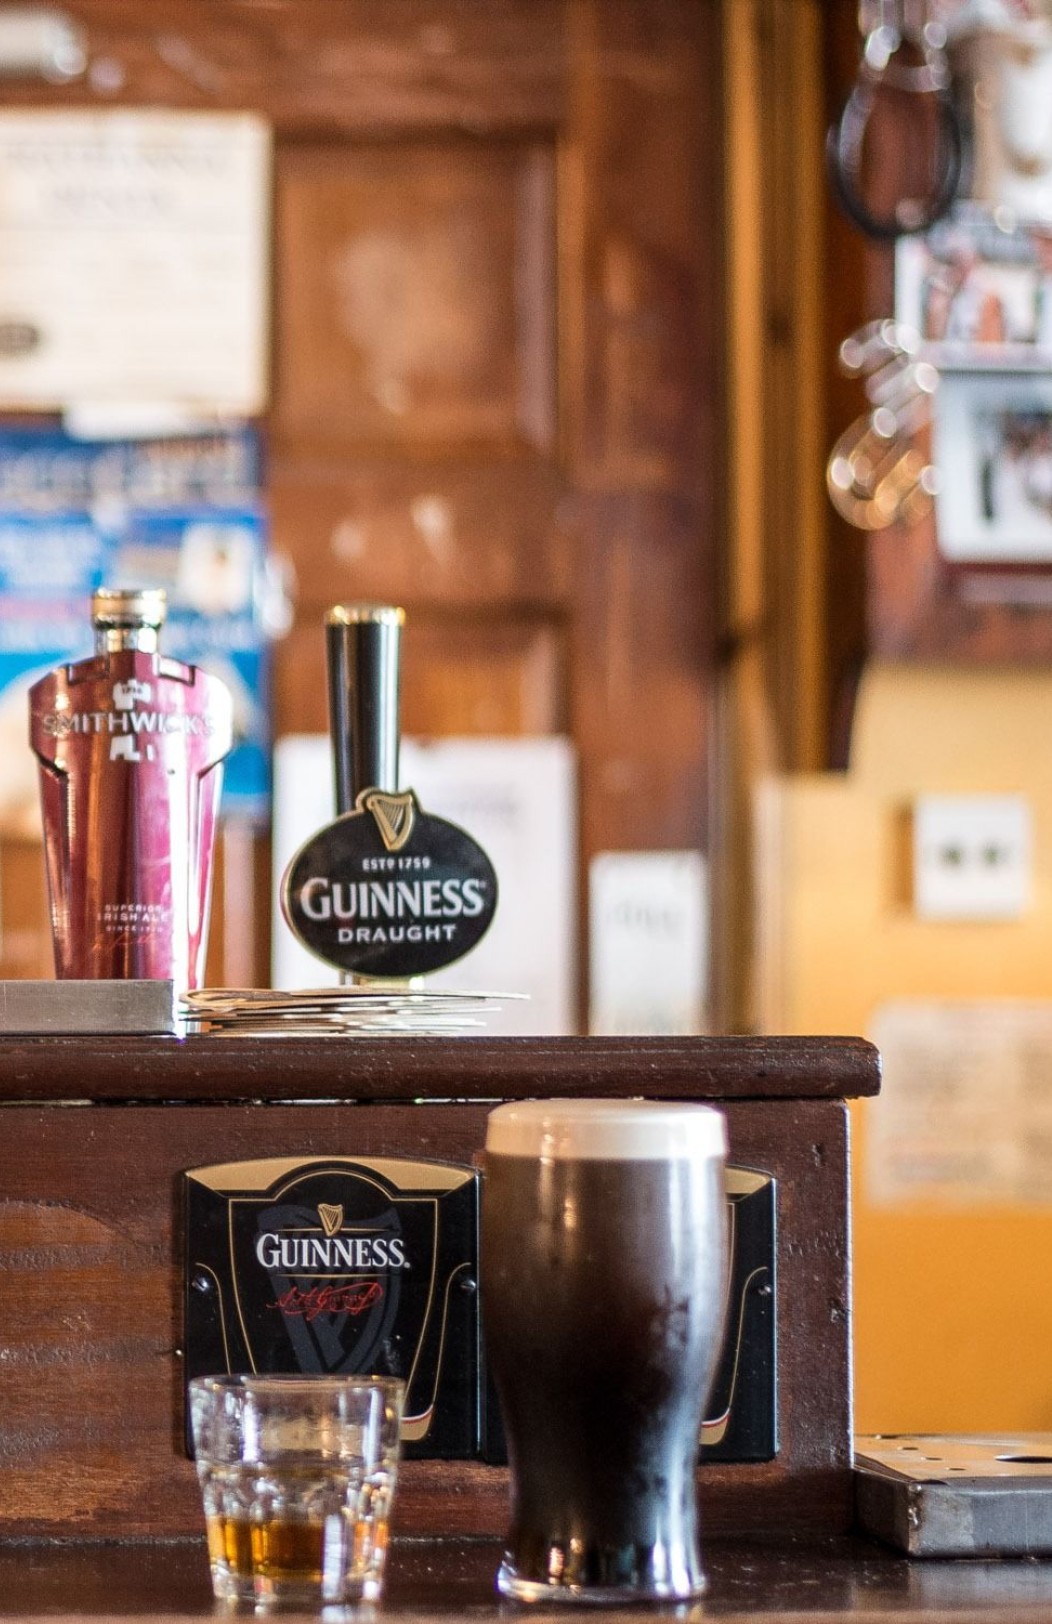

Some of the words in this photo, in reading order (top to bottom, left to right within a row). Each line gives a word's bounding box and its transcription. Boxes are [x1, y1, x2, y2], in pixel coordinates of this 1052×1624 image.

[398, 857, 431, 869] 1759
[300, 877, 484, 920] GUINNESS
[338, 924, 457, 943] DRAUGHT
